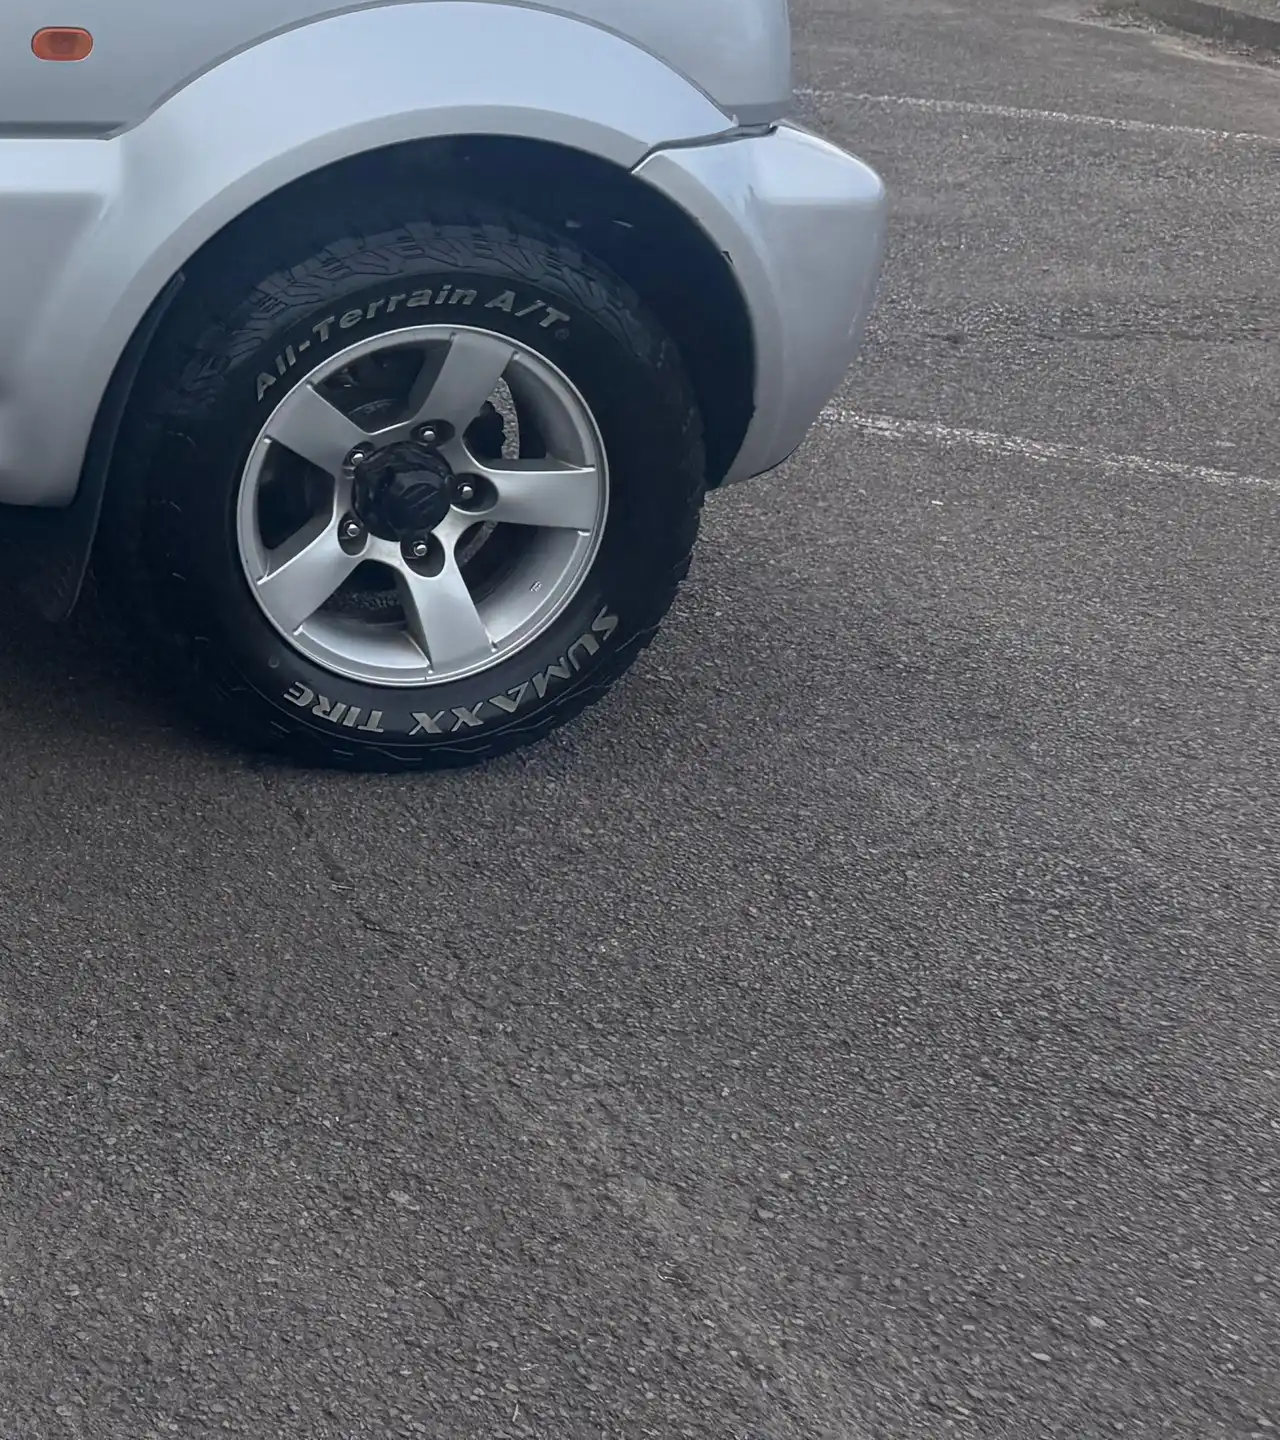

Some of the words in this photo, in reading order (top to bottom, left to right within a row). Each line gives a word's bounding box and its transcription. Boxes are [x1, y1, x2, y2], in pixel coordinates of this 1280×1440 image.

[256, 284, 477, 402] All-Terrain
[485, 290, 571, 328] A/T
[284, 681, 384, 734] TIRE
[408, 605, 619, 736] SUMAXX
